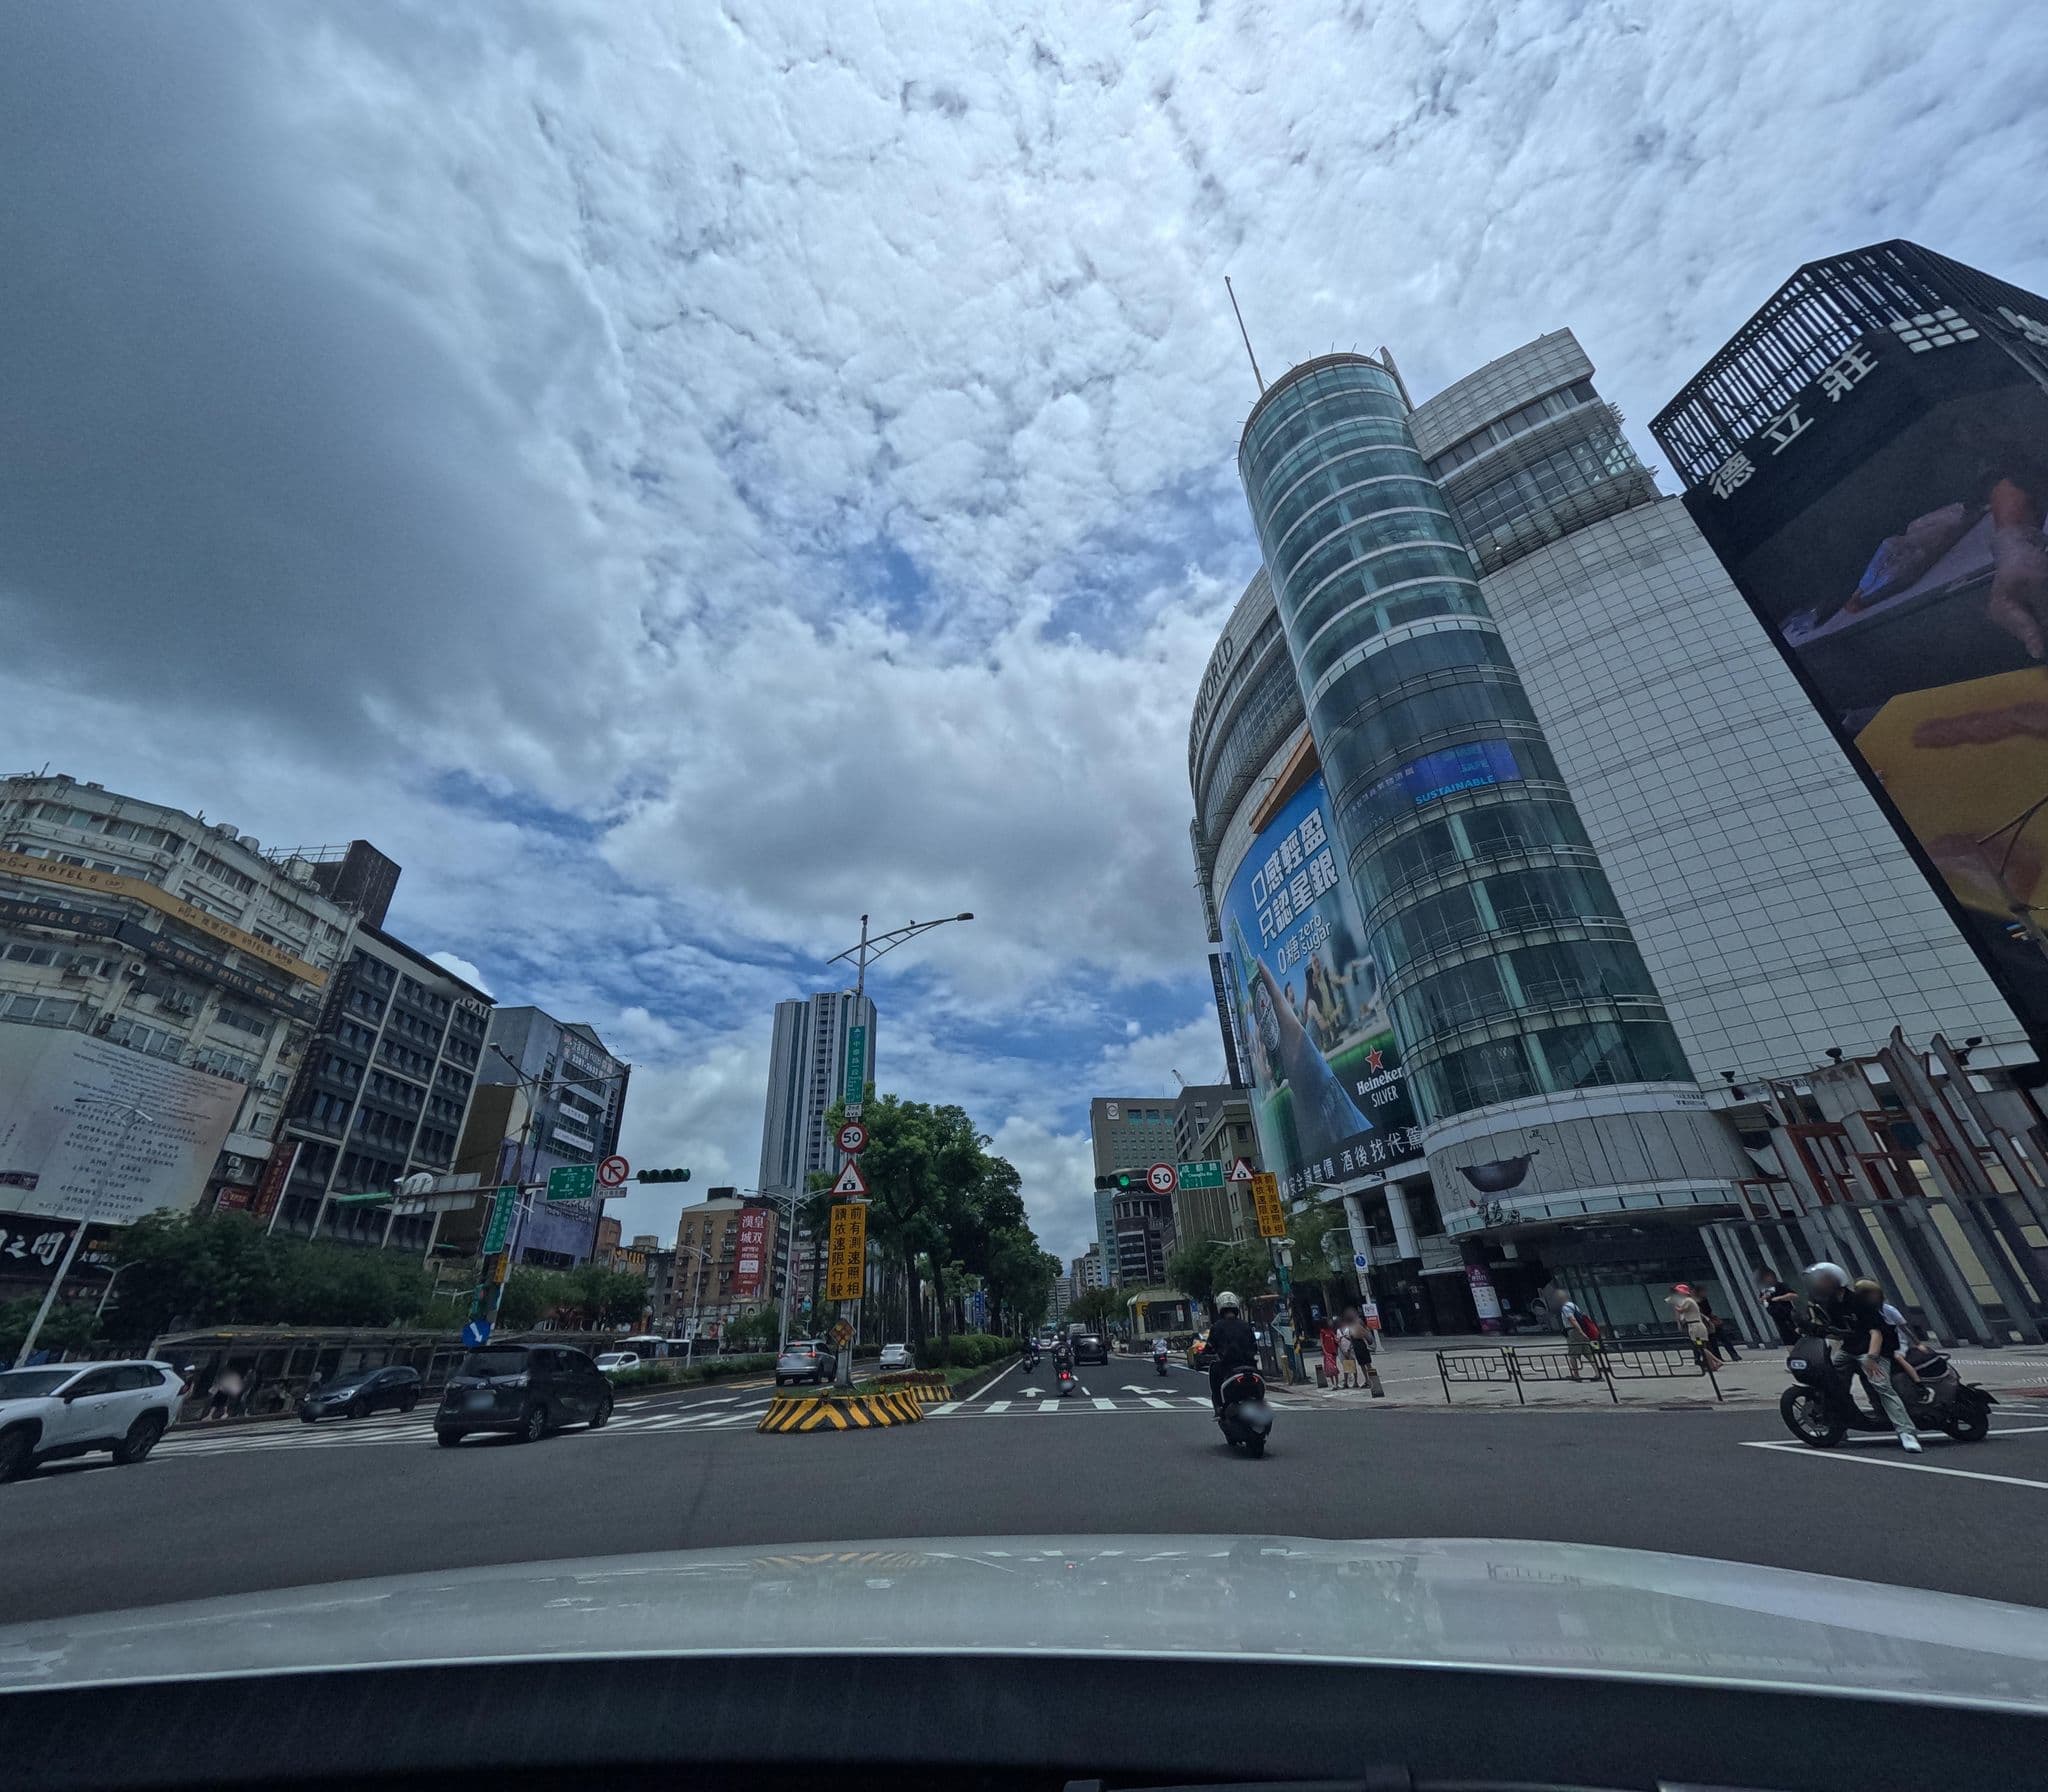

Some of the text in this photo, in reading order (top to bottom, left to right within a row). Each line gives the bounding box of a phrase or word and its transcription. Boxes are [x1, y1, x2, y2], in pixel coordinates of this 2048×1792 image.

[1415, 775, 1496, 805] SUSTAINABLE
[1252, 807, 1327, 911] 口感輕盈
[1259, 846, 1339, 949] 只認星銀
[1300, 914, 1322, 940] zero
[1302, 922, 1331, 956] sugar
[1371, 1085, 1399, 1108] SILVER
[843, 1132, 861, 1143] 50
[1153, 1173, 1171, 1184] 50
[831, 1208, 847, 1297] 請依速限行駛
[847, 1207, 862, 1295] 前有測速照相
